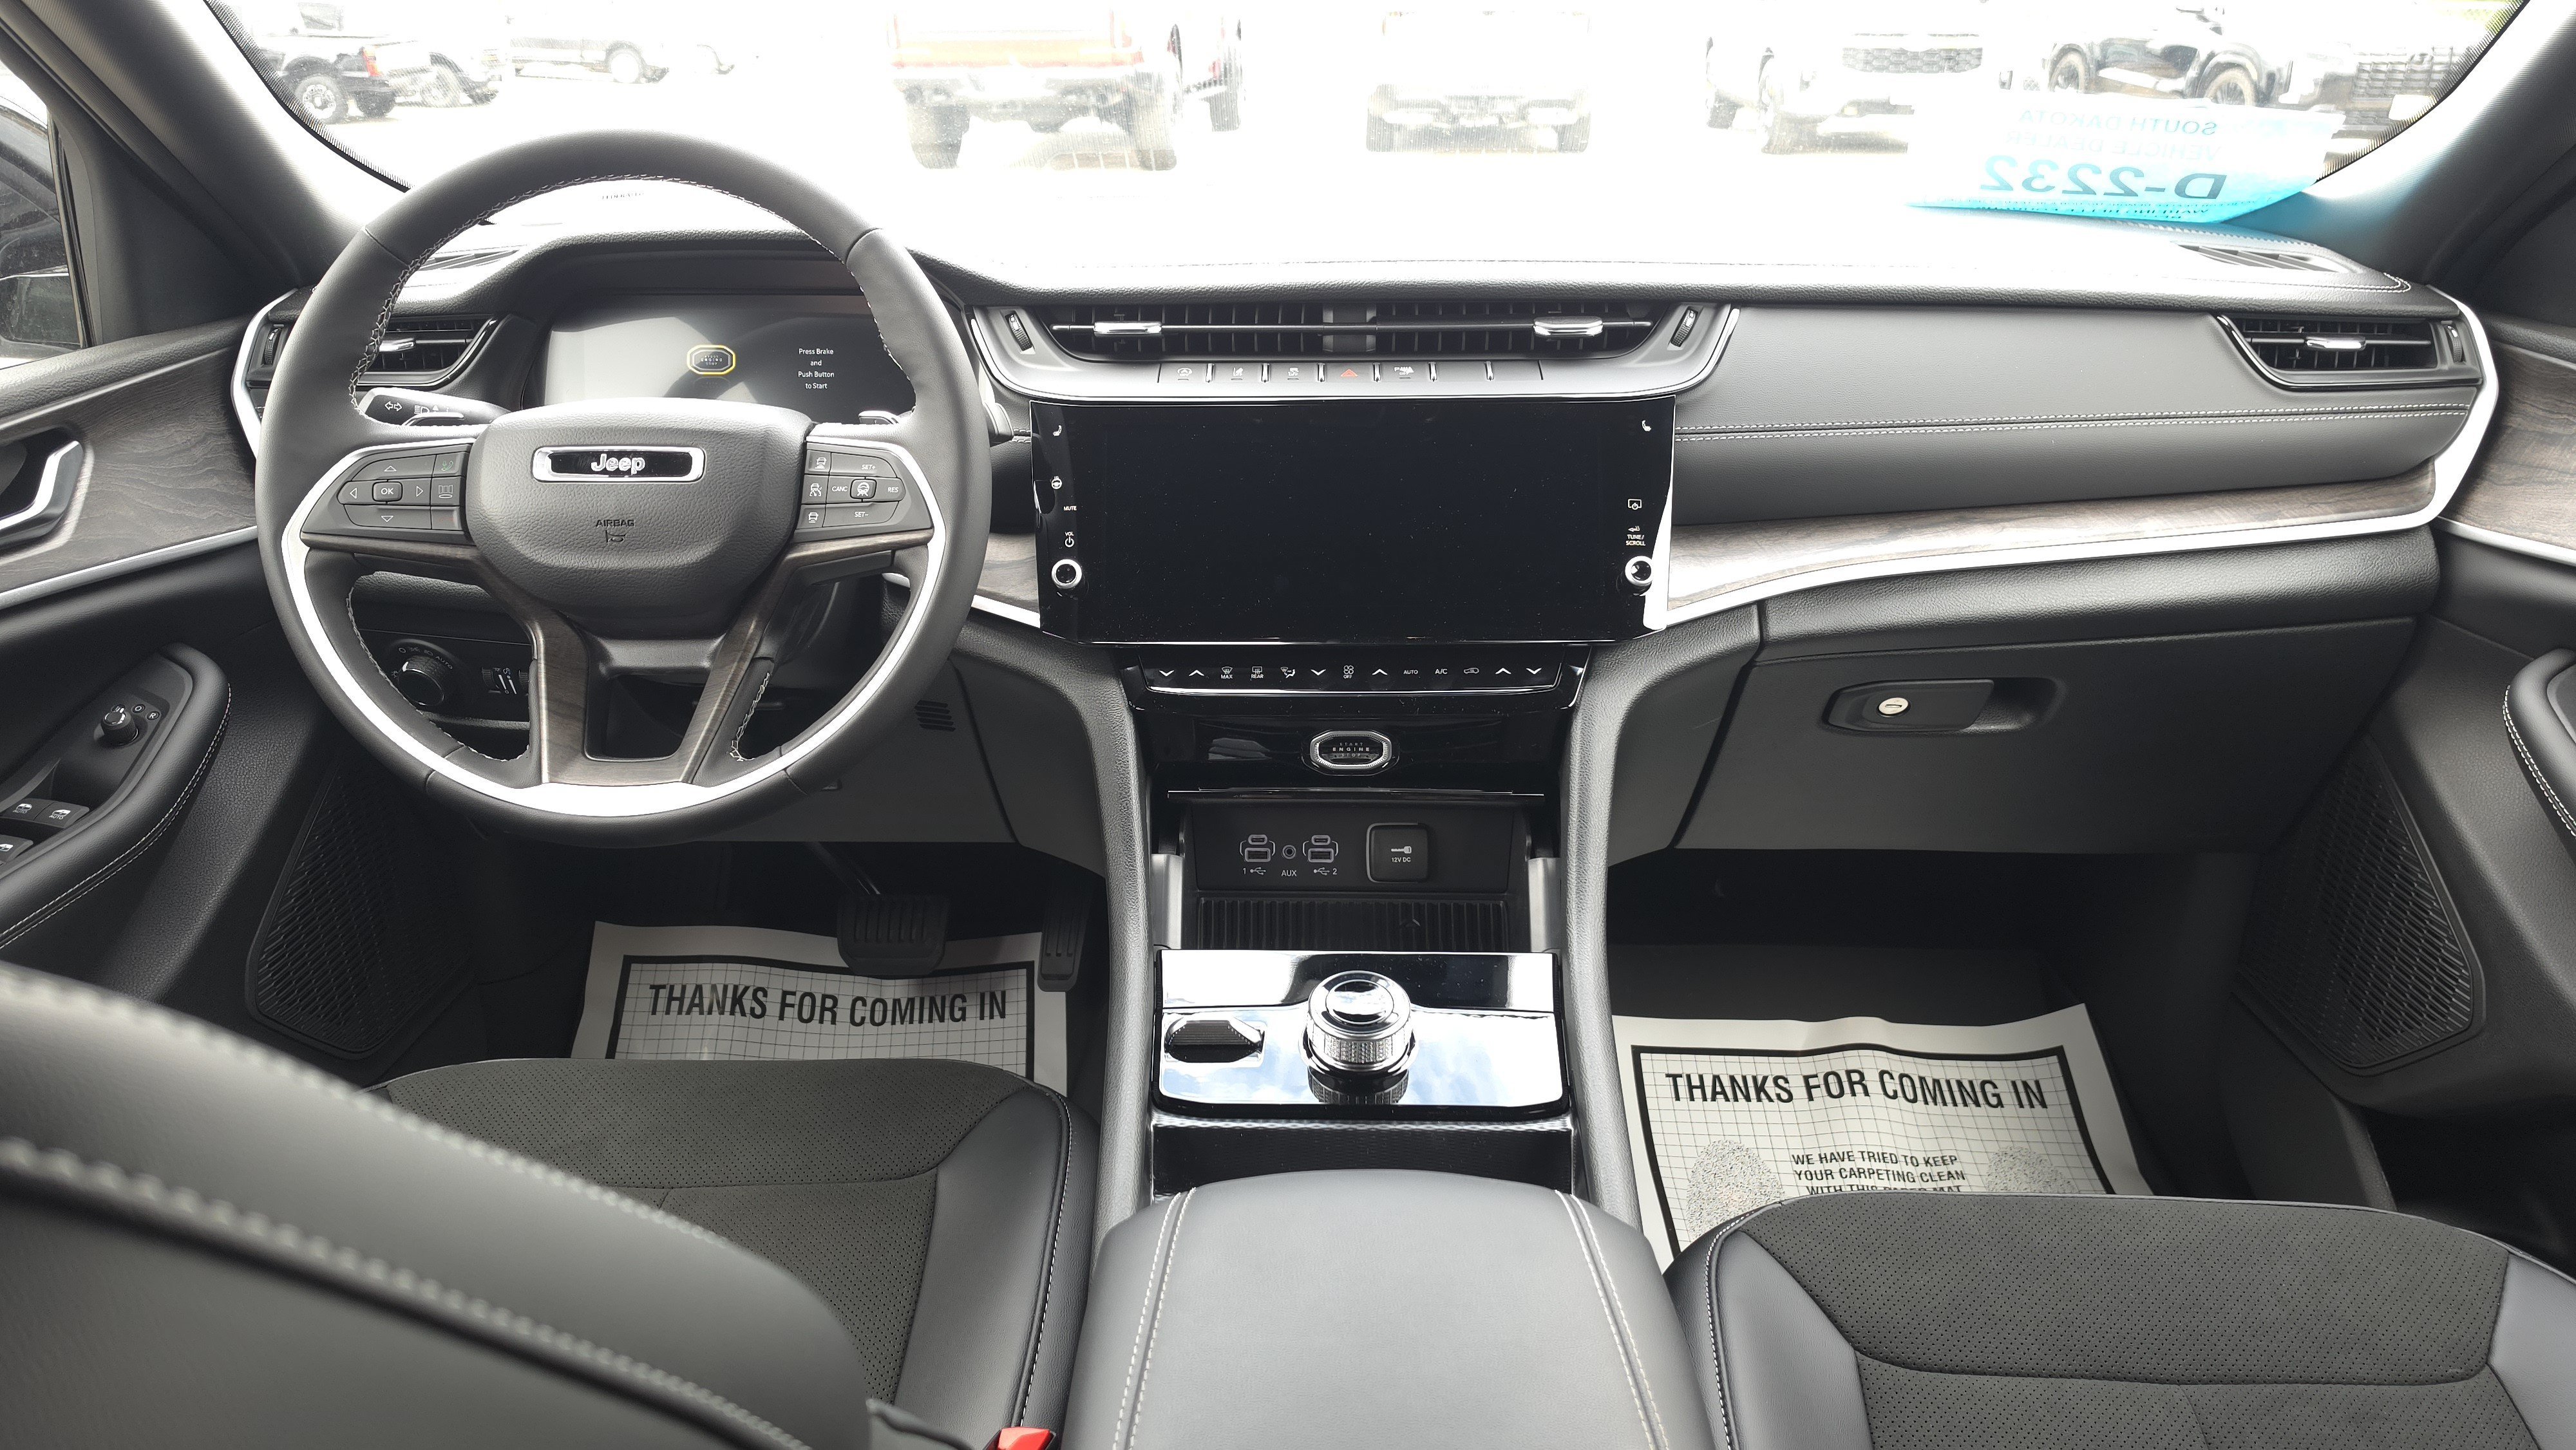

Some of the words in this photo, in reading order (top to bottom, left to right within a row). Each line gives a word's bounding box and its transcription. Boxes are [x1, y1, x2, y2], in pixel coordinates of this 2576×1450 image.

[591, 453, 645, 475] Jeep
[595, 519, 636, 527] AIRBAG
[435, 655, 453, 670] AUTO
[649, 983, 768, 1021] THANKS
[778, 990, 839, 1025] FOR
[848, 993, 969, 1027] COMING
[978, 989, 1008, 1021] IN
[1665, 1072, 1794, 1104] THANKS
[1803, 1068, 1870, 1102] FOR
[1879, 1068, 2004, 1109] COMING
[2009, 1079, 2049, 1109] IN
[1792, 1153, 1815, 1165] WE
[1818, 1150, 1855, 1165] HAVE
[1858, 1150, 1899, 1164] TRIED
[1900, 1154, 1920, 1167] TO
[1924, 1154, 1958, 1167] KEEP
[1794, 1169, 1835, 1181] YOUR
[1839, 1167, 1917, 1183] CARPETING
[1919, 1170, 1966, 1183] CLEAN
[1806, 1185, 1842, 1195] WITH
